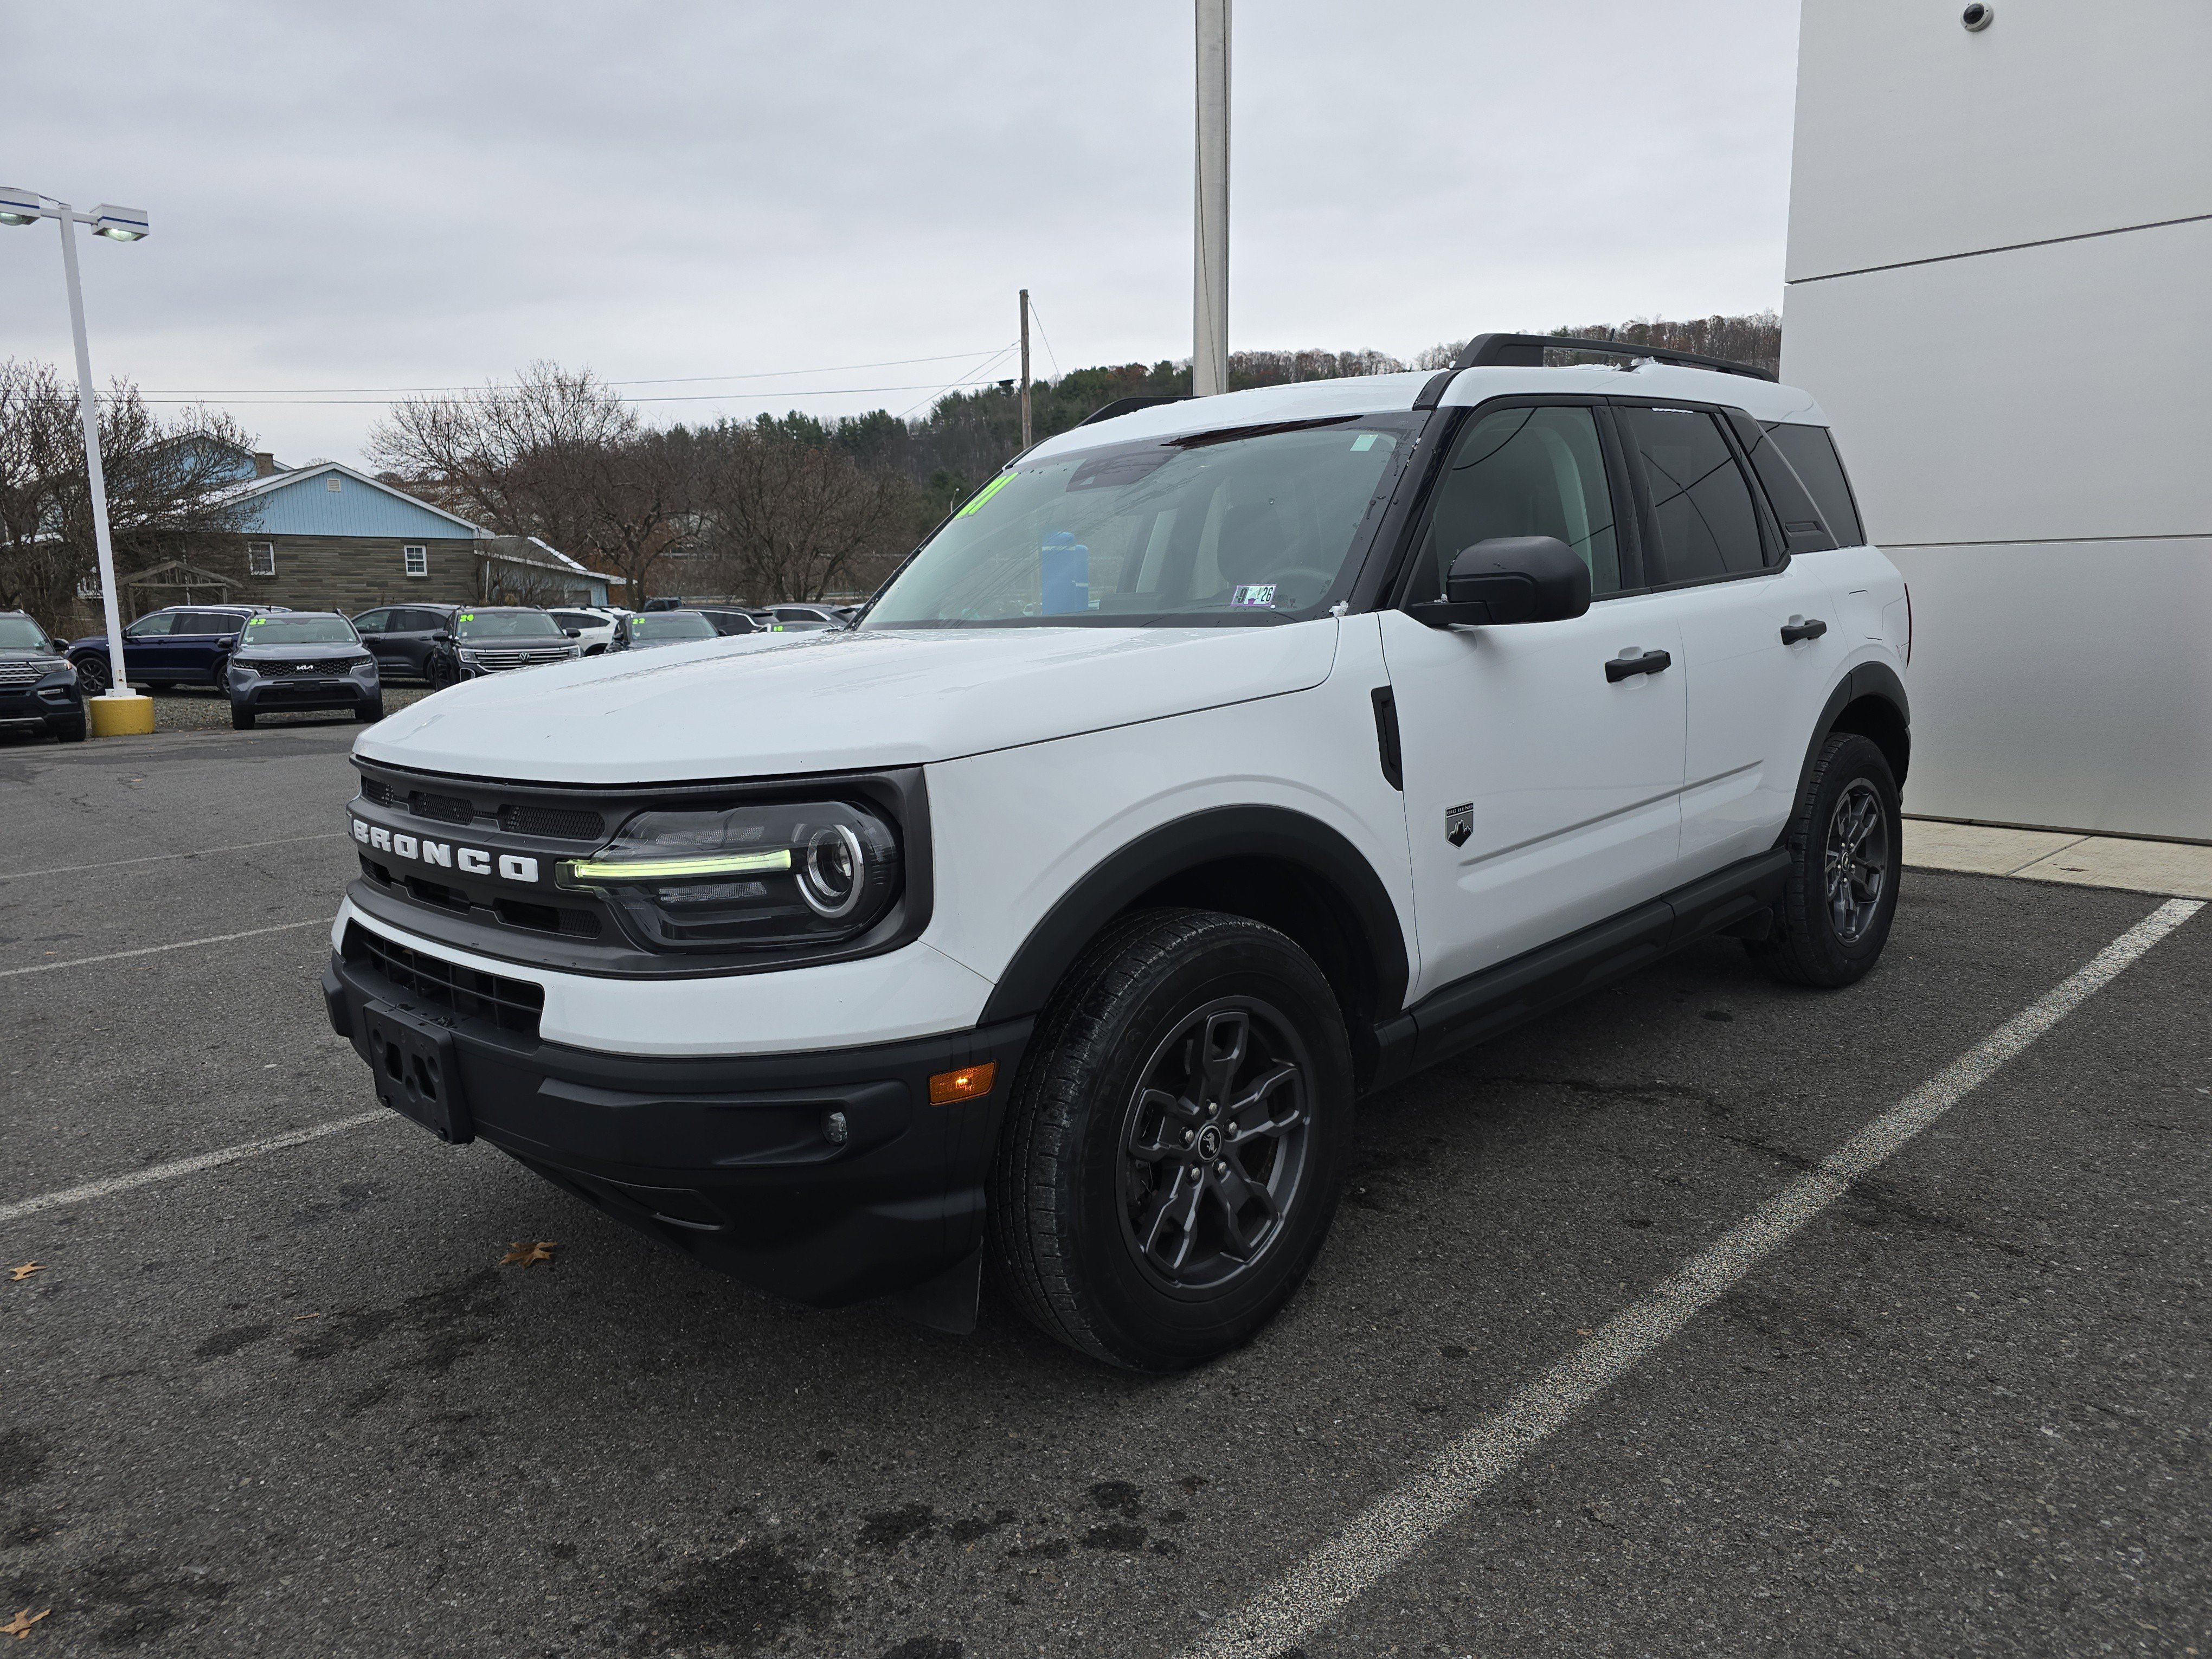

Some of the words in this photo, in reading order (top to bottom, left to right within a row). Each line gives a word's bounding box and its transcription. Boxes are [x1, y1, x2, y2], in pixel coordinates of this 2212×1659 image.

[1237, 588, 1247, 603] 9
[1261, 587, 1273, 601] 26
[1457, 804, 1473, 812] BEND
[353, 819, 538, 883] BRONCO
